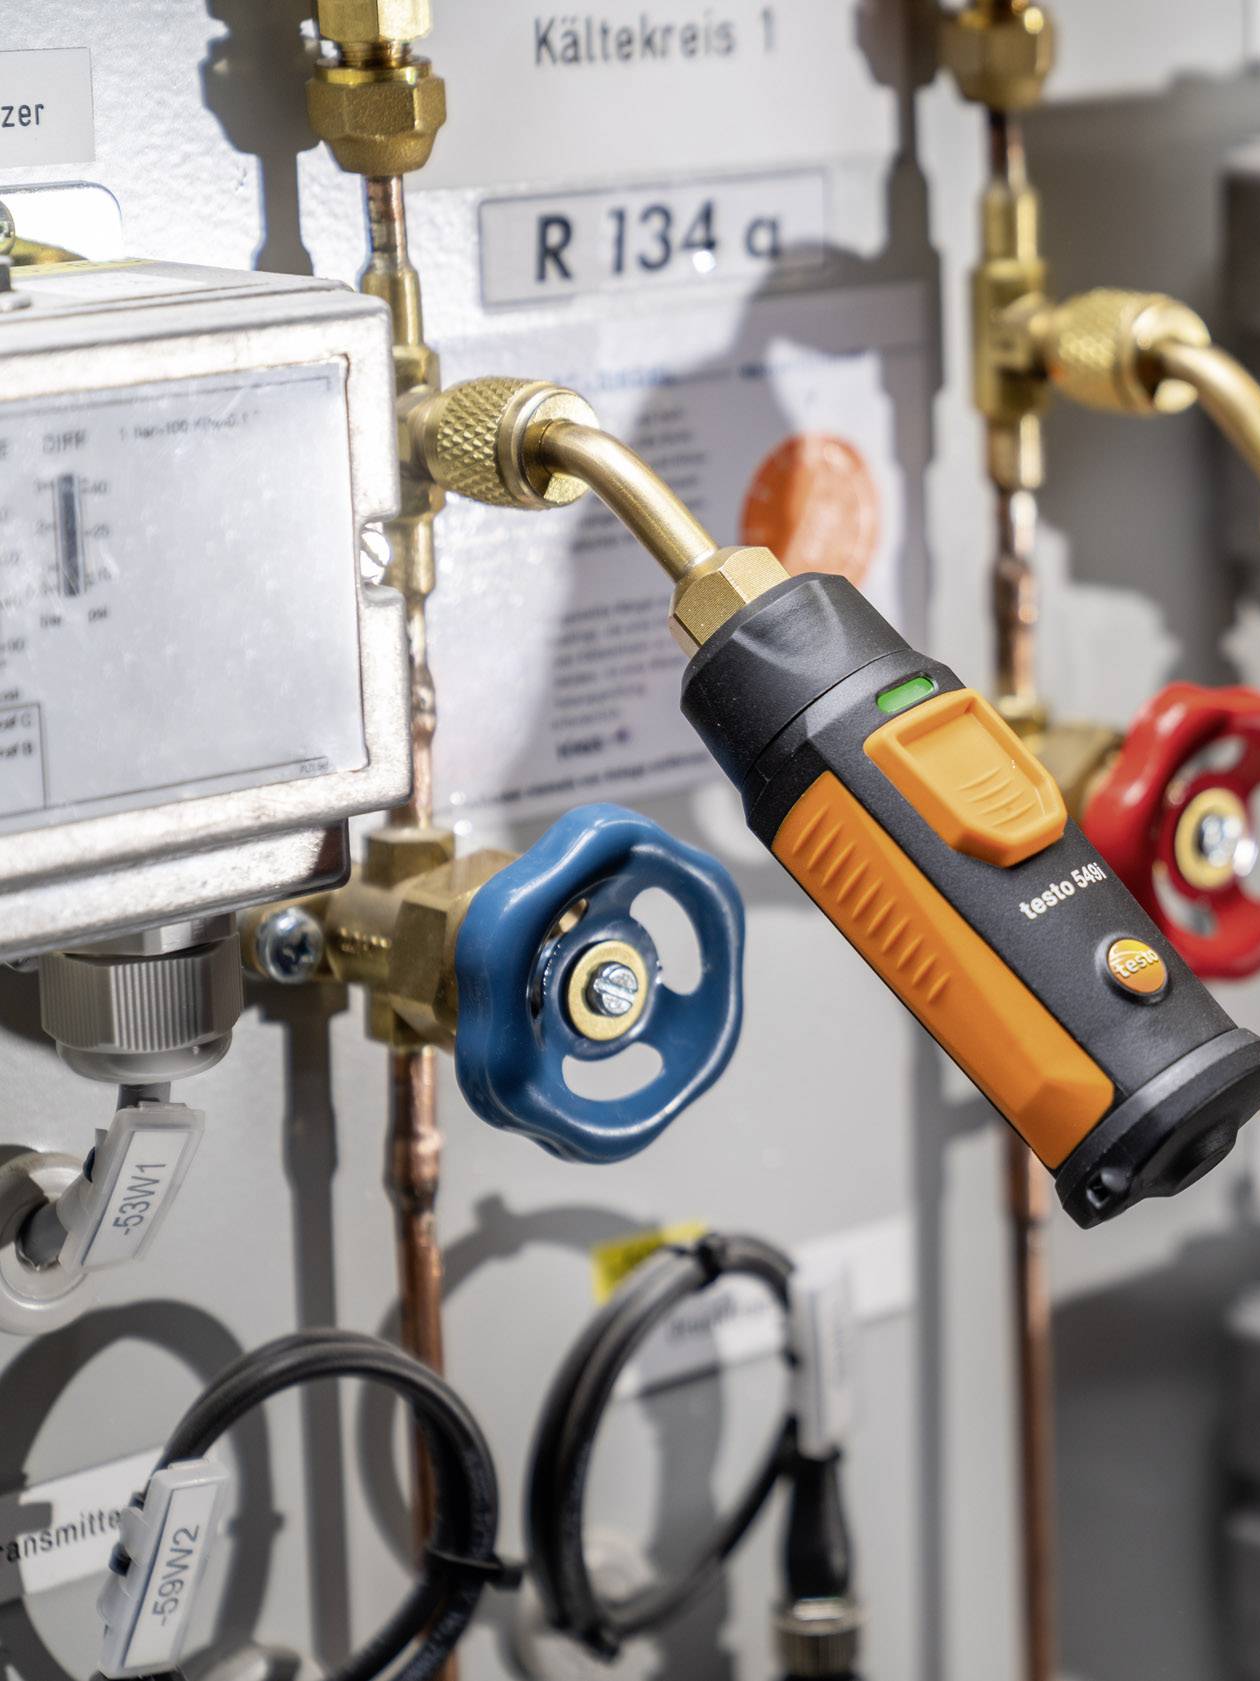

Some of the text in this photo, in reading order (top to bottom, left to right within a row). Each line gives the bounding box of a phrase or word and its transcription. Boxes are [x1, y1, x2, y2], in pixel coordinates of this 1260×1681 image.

[533, 6, 777, 66] Kältekreis 1
[1, 103, 44, 128] zer
[535, 198, 782, 283] R 134 a
[1019, 862, 1108, 920] testo 549i
[1114, 949, 1161, 979] testo
[112, 1164, 167, 1235] -53W1
[0, 1508, 121, 1563] ansmitte
[152, 1525, 200, 1627] -59W2
